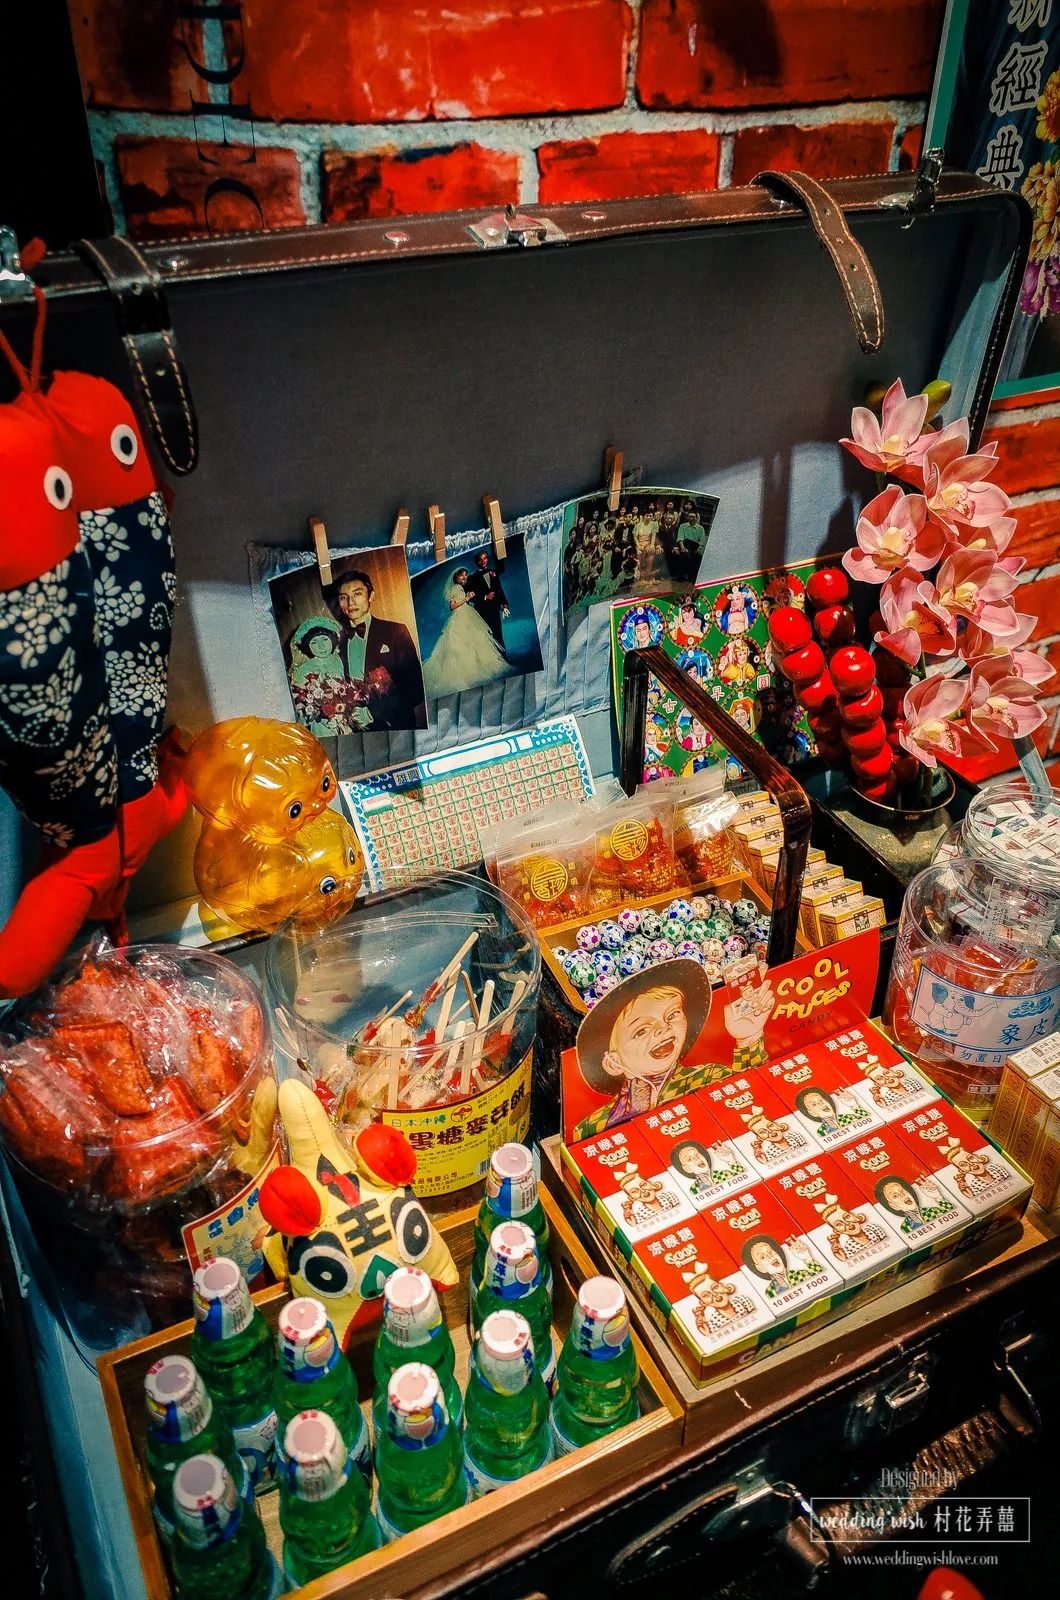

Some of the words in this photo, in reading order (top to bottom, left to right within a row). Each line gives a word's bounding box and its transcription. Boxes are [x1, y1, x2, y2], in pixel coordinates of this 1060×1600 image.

[776, 958, 850, 997] COOL
[772, 980, 852, 1020] FAUCES
[788, 1012, 833, 1033] CANDY
[961, 1049, 1009, 1063] 勿置日
[400, 1079, 526, 1152] 黑糖麥芽餅
[823, 1135, 833, 1144] 10
[833, 1127, 851, 1140] BEST
[853, 1117, 873, 1130] FOOD
[695, 1193, 705, 1202] 10
[705, 1184, 725, 1197] BEST
[728, 1173, 749, 1187] FOOD
[908, 1232, 918, 1241] 10
[918, 1222, 936, 1236] BEST
[938, 1211, 960, 1225] FOOD
[772, 1299, 783, 1309] 10
[783, 1288, 804, 1303] BEST
[807, 1275, 829, 1290] FOOD
